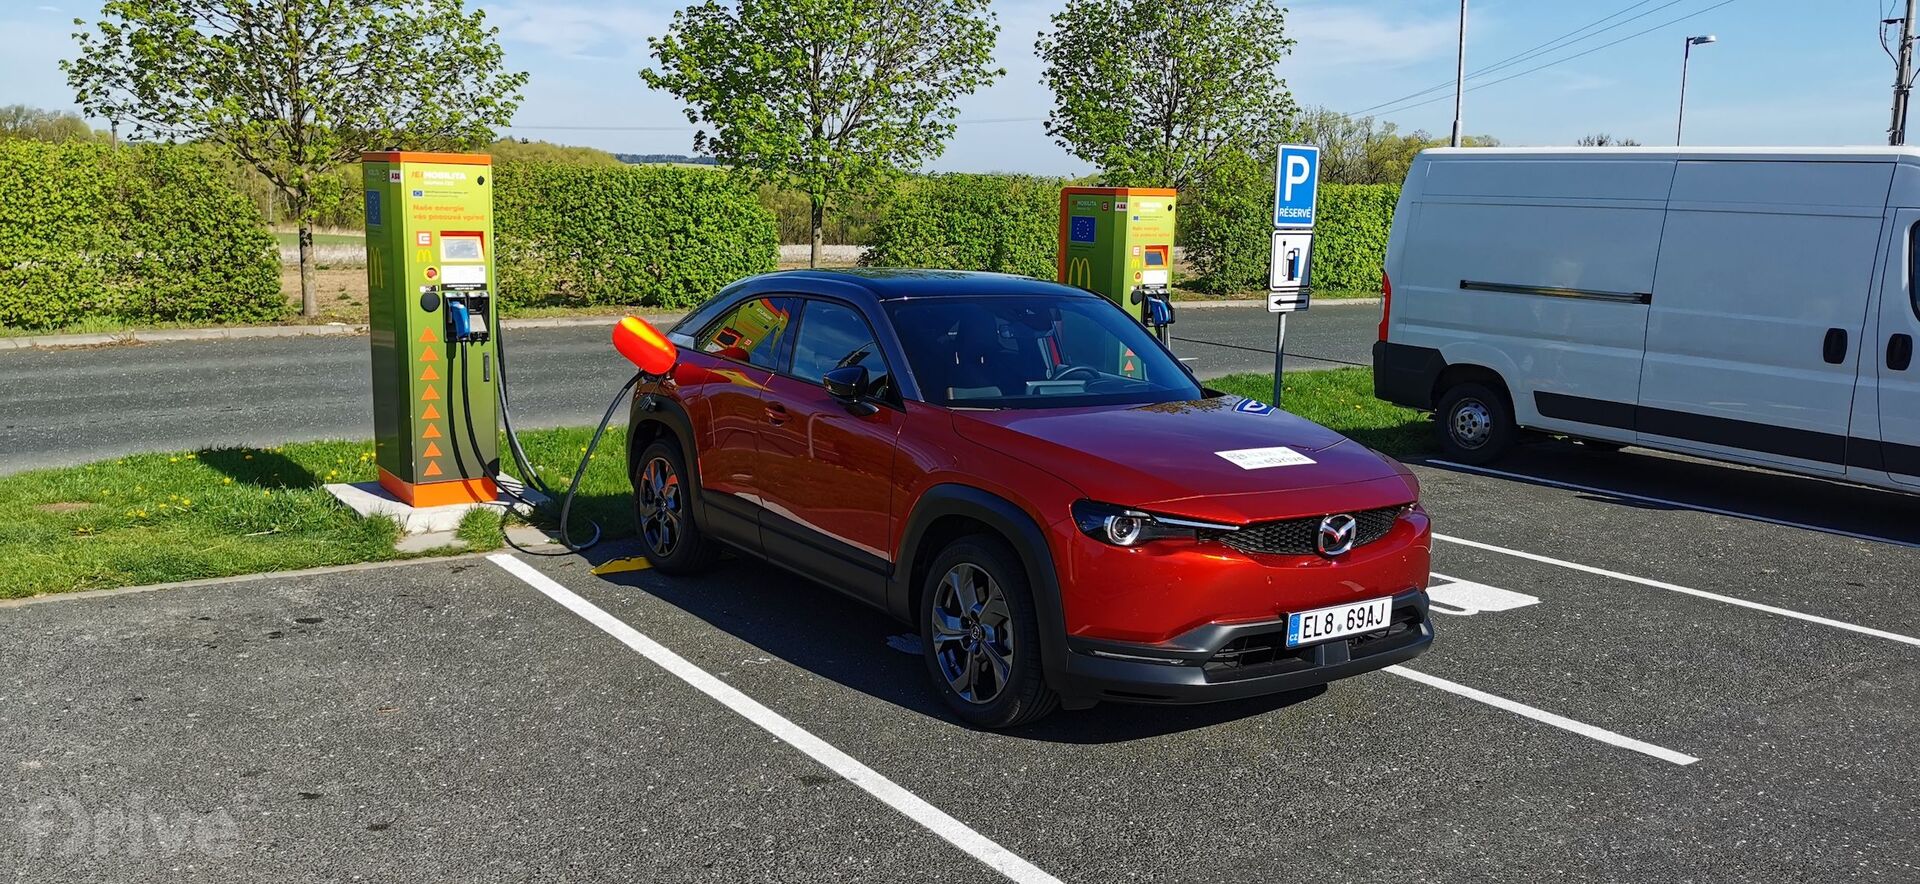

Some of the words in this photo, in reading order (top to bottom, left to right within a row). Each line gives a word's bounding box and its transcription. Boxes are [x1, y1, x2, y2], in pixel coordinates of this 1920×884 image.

[1285, 155, 1310, 202] P
[1279, 206, 1311, 219] RÉSERVÉ
[1303, 612, 1333, 639] EL8
[1346, 602, 1384, 631] 69AJ
